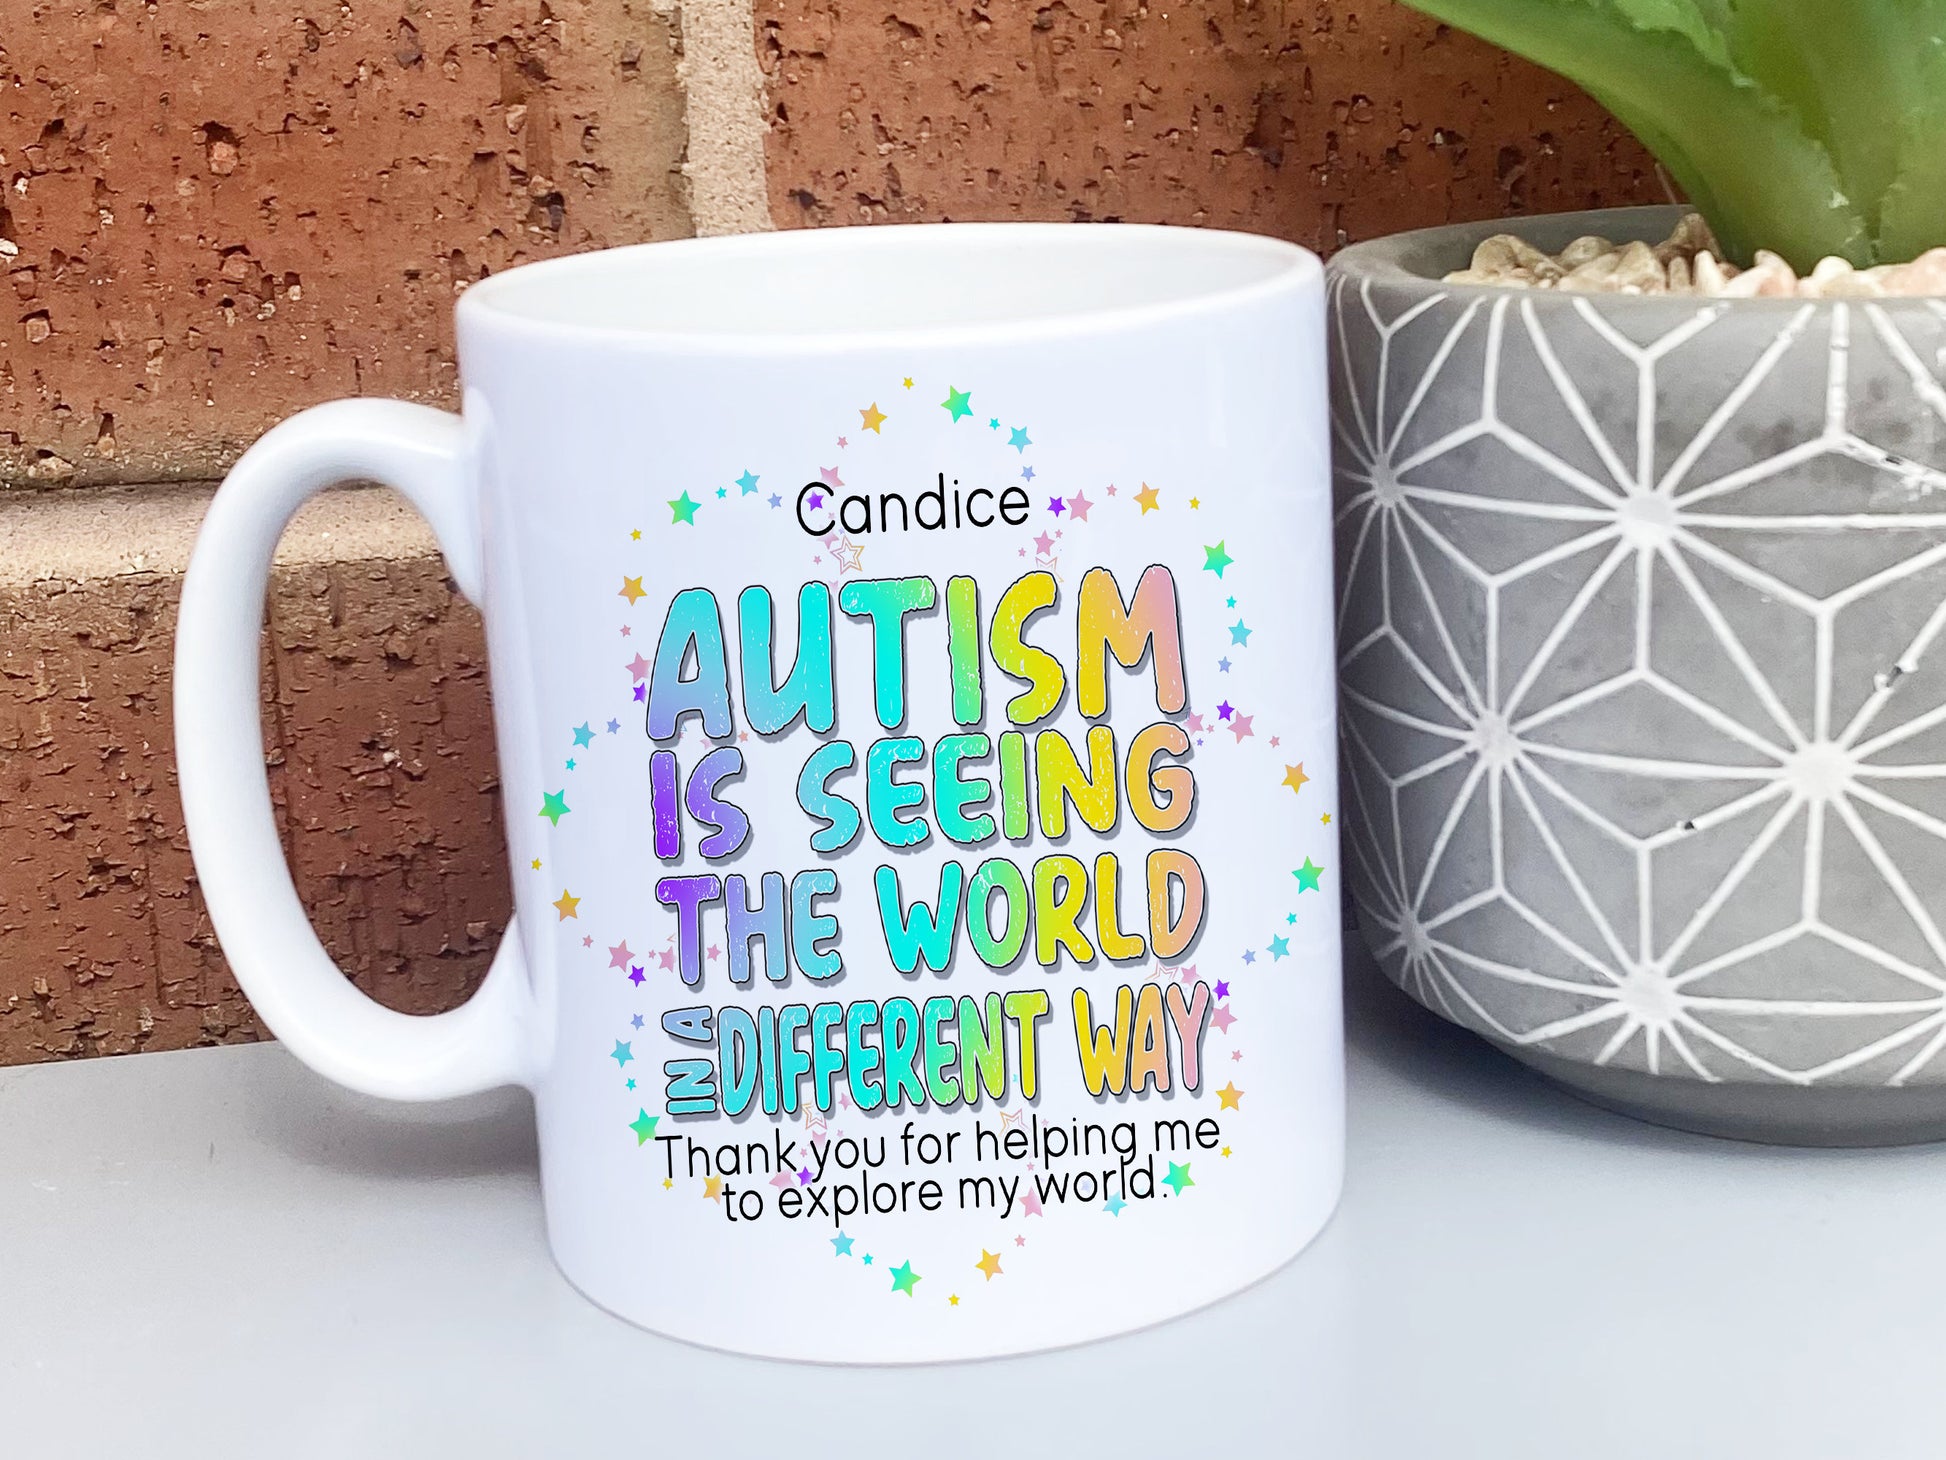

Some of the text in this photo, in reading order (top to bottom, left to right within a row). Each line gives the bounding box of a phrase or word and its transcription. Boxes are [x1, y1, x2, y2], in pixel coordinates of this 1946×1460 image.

[797, 473, 1030, 536] Candice
[646, 563, 1187, 742] AUTISM
[649, 721, 1196, 859] IS SEEING
[655, 848, 1208, 986] THE WORLD
[661, 1004, 717, 1115] IN A
[715, 981, 1211, 1117] DIFFERENT WAY
[655, 1112, 1220, 1183] Thank you for helping me
[721, 1155, 1168, 1228] to explore my world.
